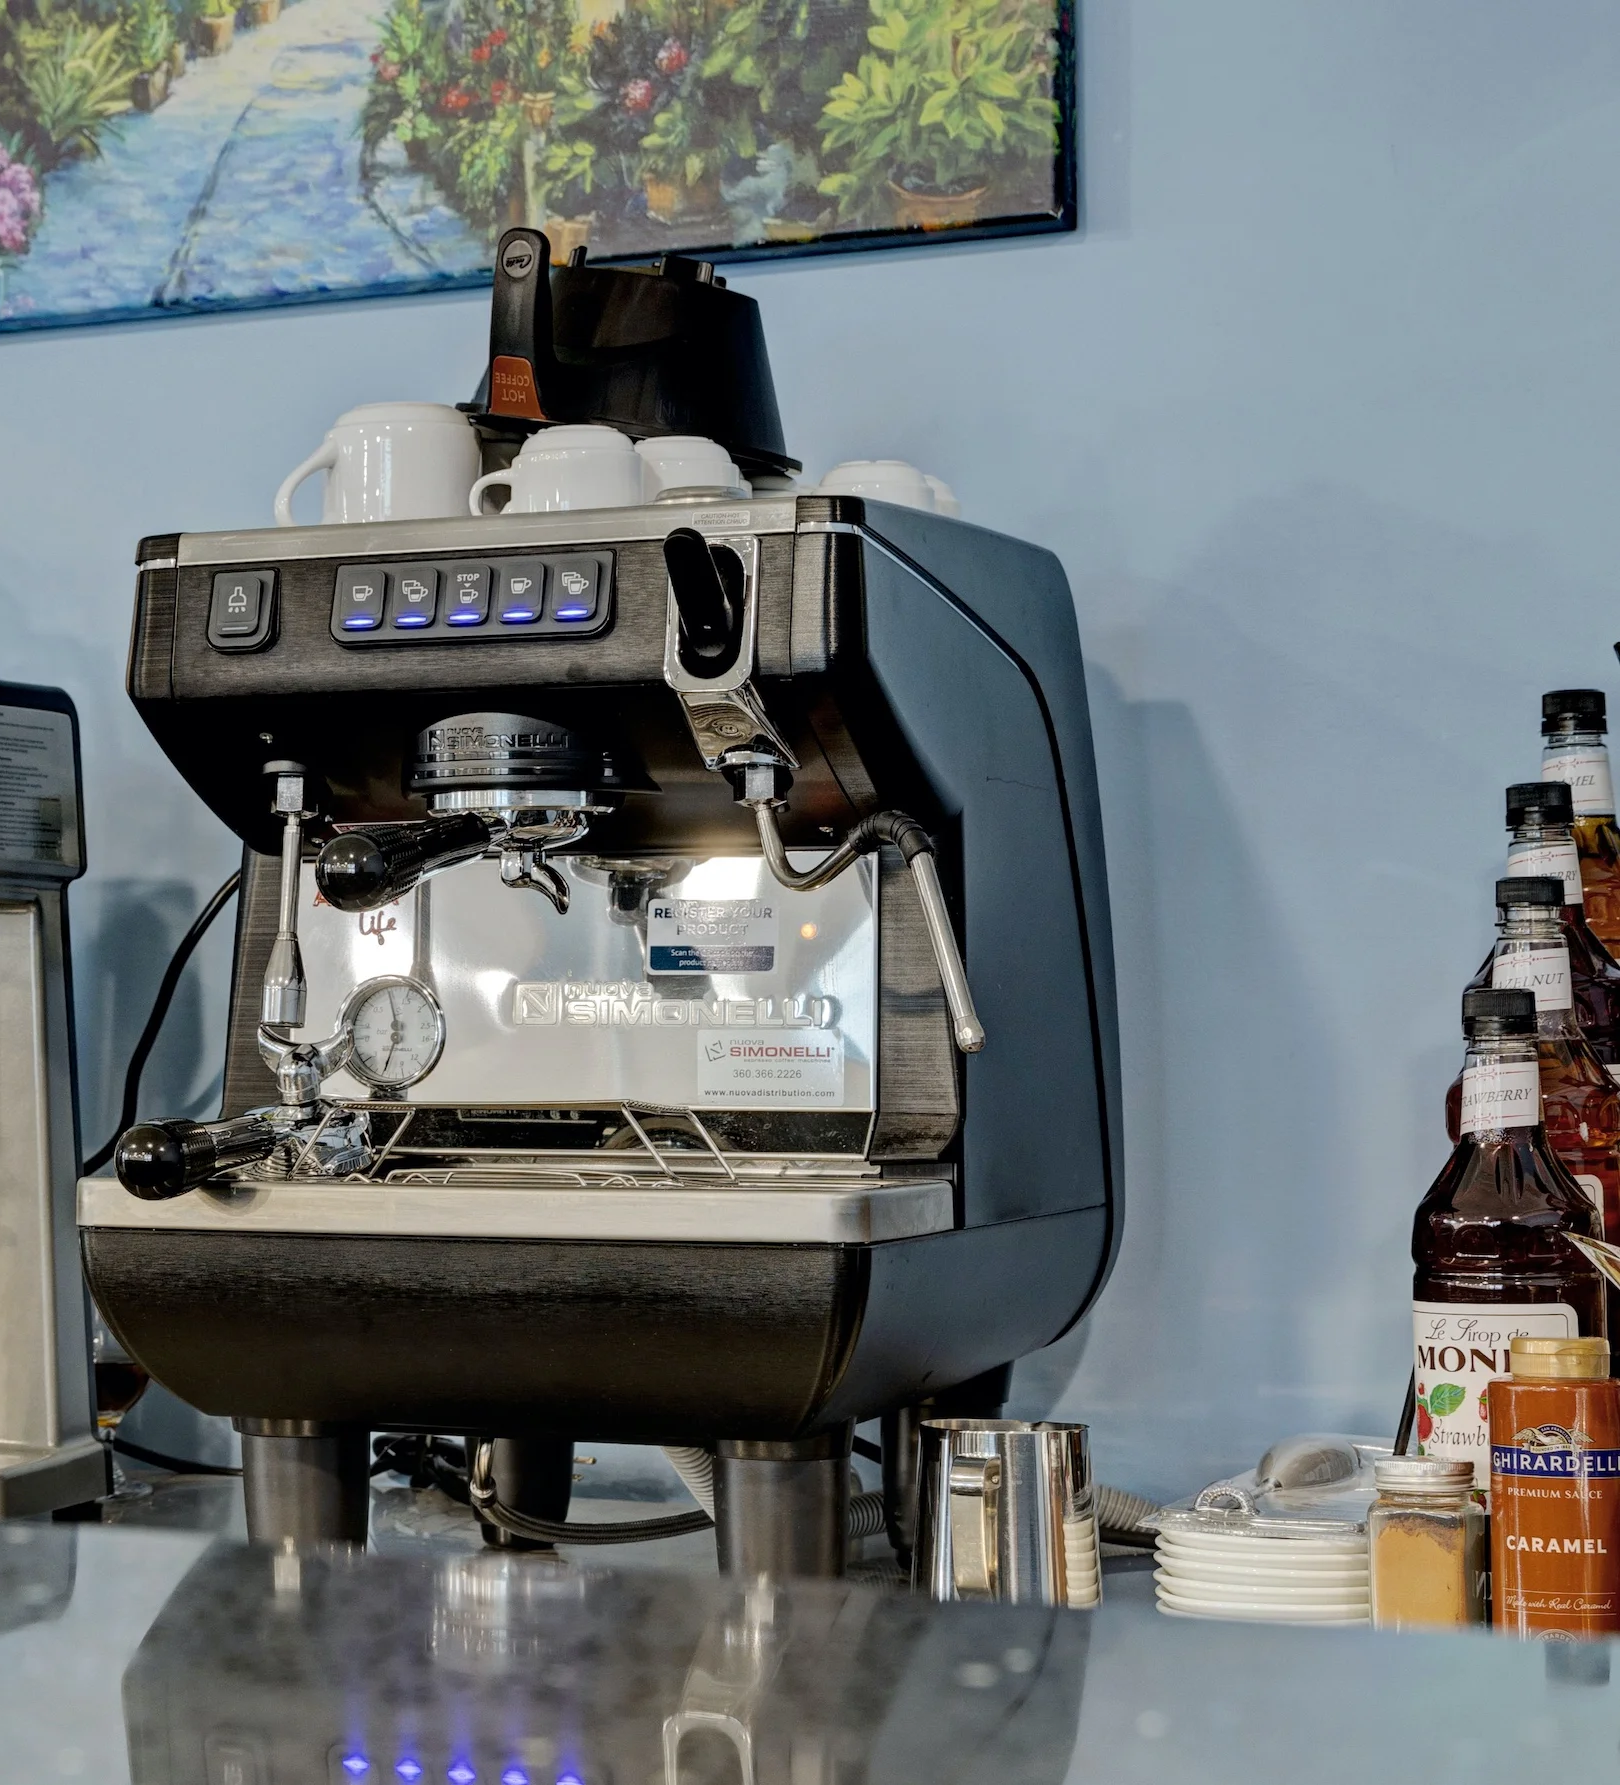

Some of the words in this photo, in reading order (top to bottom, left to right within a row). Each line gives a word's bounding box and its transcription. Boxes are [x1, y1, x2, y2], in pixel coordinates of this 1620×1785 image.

[495, 372, 530, 387] COFFEE
[502, 388, 527, 403] HOT
[457, 573, 480, 582] STOP
[447, 733, 569, 749] SIMONELLI
[654, 907, 725, 919] REGISTER
[730, 907, 773, 919] YOUR
[359, 911, 397, 946] life
[677, 923, 749, 936] PRODUCT
[670, 949, 687, 957] Scan
[563, 979, 654, 997] nuova
[1492, 972, 1565, 989] AZELNUT
[565, 998, 826, 1028] SIMONELLI
[730, 1047, 830, 1057] SIMONELLI
[733, 1069, 802, 1079] 360.366.2226
[704, 1089, 835, 1097] www.nuovadistribution.com
[1462, 1088, 1532, 1108] RAWBERRY
[1425, 1318, 1447, 1340] Le
[1451, 1318, 1501, 1348] Sirop
[1418, 1345, 1511, 1374] MONI
[1428, 1424, 1490, 1450] Strawb
[1507, 1487, 1561, 1499] PREMIUM
[1564, 1490, 1603, 1499] SAUCE
[1506, 1535, 1607, 1554] CARAMEL
[1528, 1600, 1547, 1608] with
[1548, 1598, 1572, 1610] Real
[1573, 1598, 1612, 1611] Caramel
